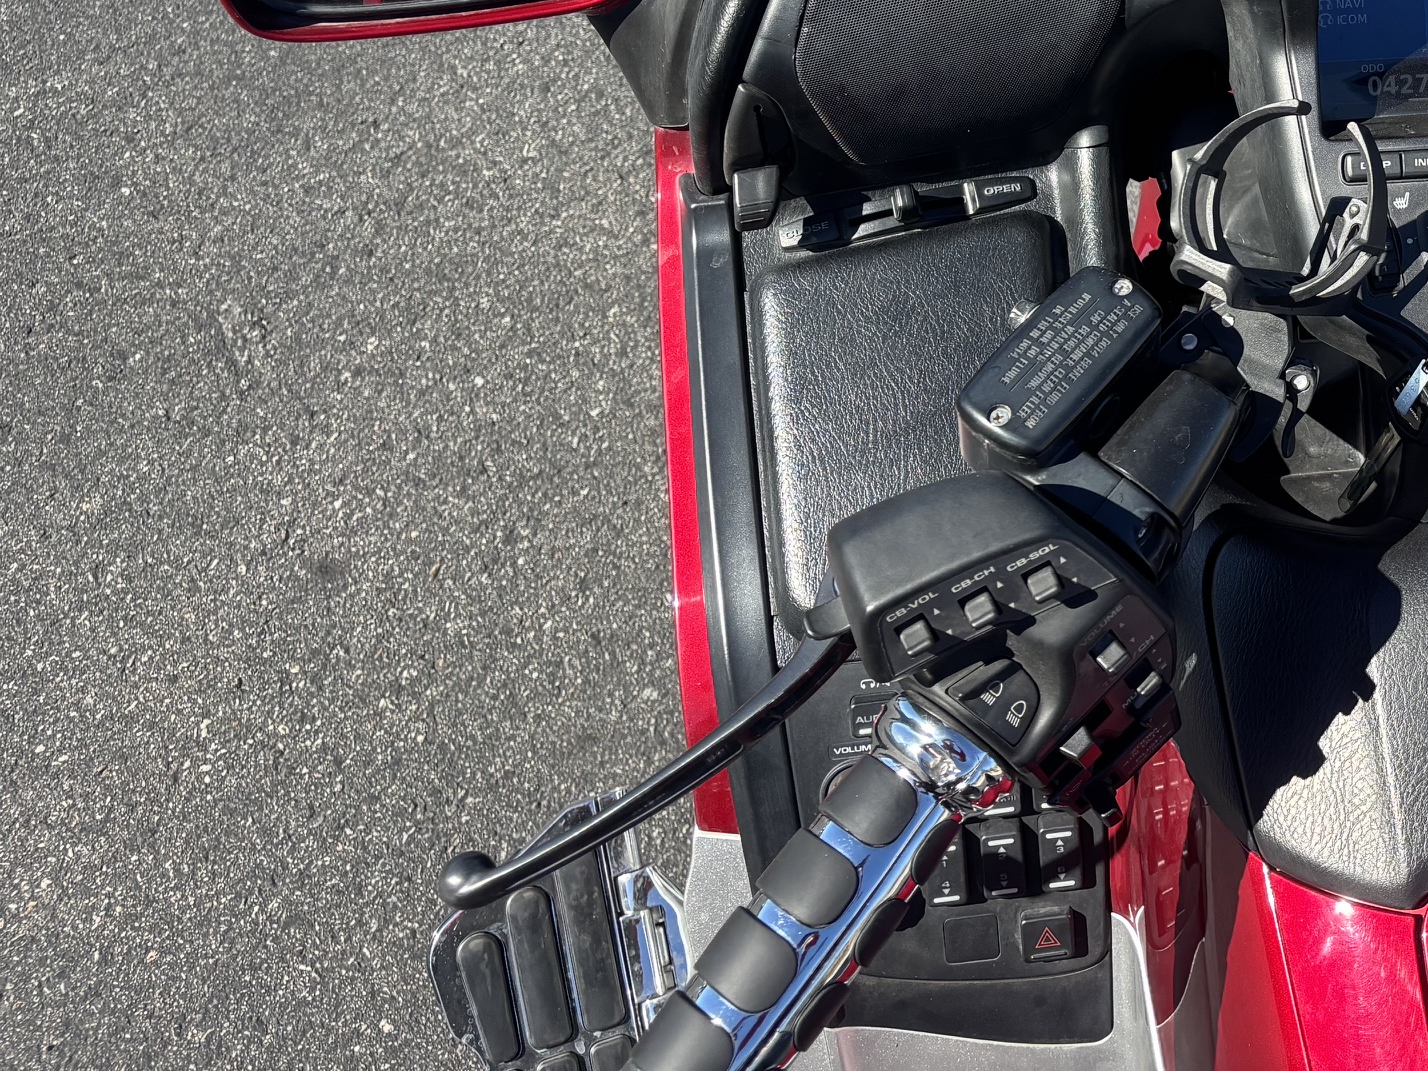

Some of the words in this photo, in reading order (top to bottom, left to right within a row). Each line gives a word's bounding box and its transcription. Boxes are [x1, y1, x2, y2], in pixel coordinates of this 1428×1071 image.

[1337, 14, 1368, 25] ICOM
[1361, 63, 1385, 73] ODO
[984, 182, 1023, 196] OPEN
[1006, 544, 1060, 572] CB-SQL
[950, 566, 996, 594] CB-CH
[885, 591, 939, 623] CB-VOL
[1079, 603, 1124, 646] VOLUME
[833, 744, 871, 754] VOLUM
